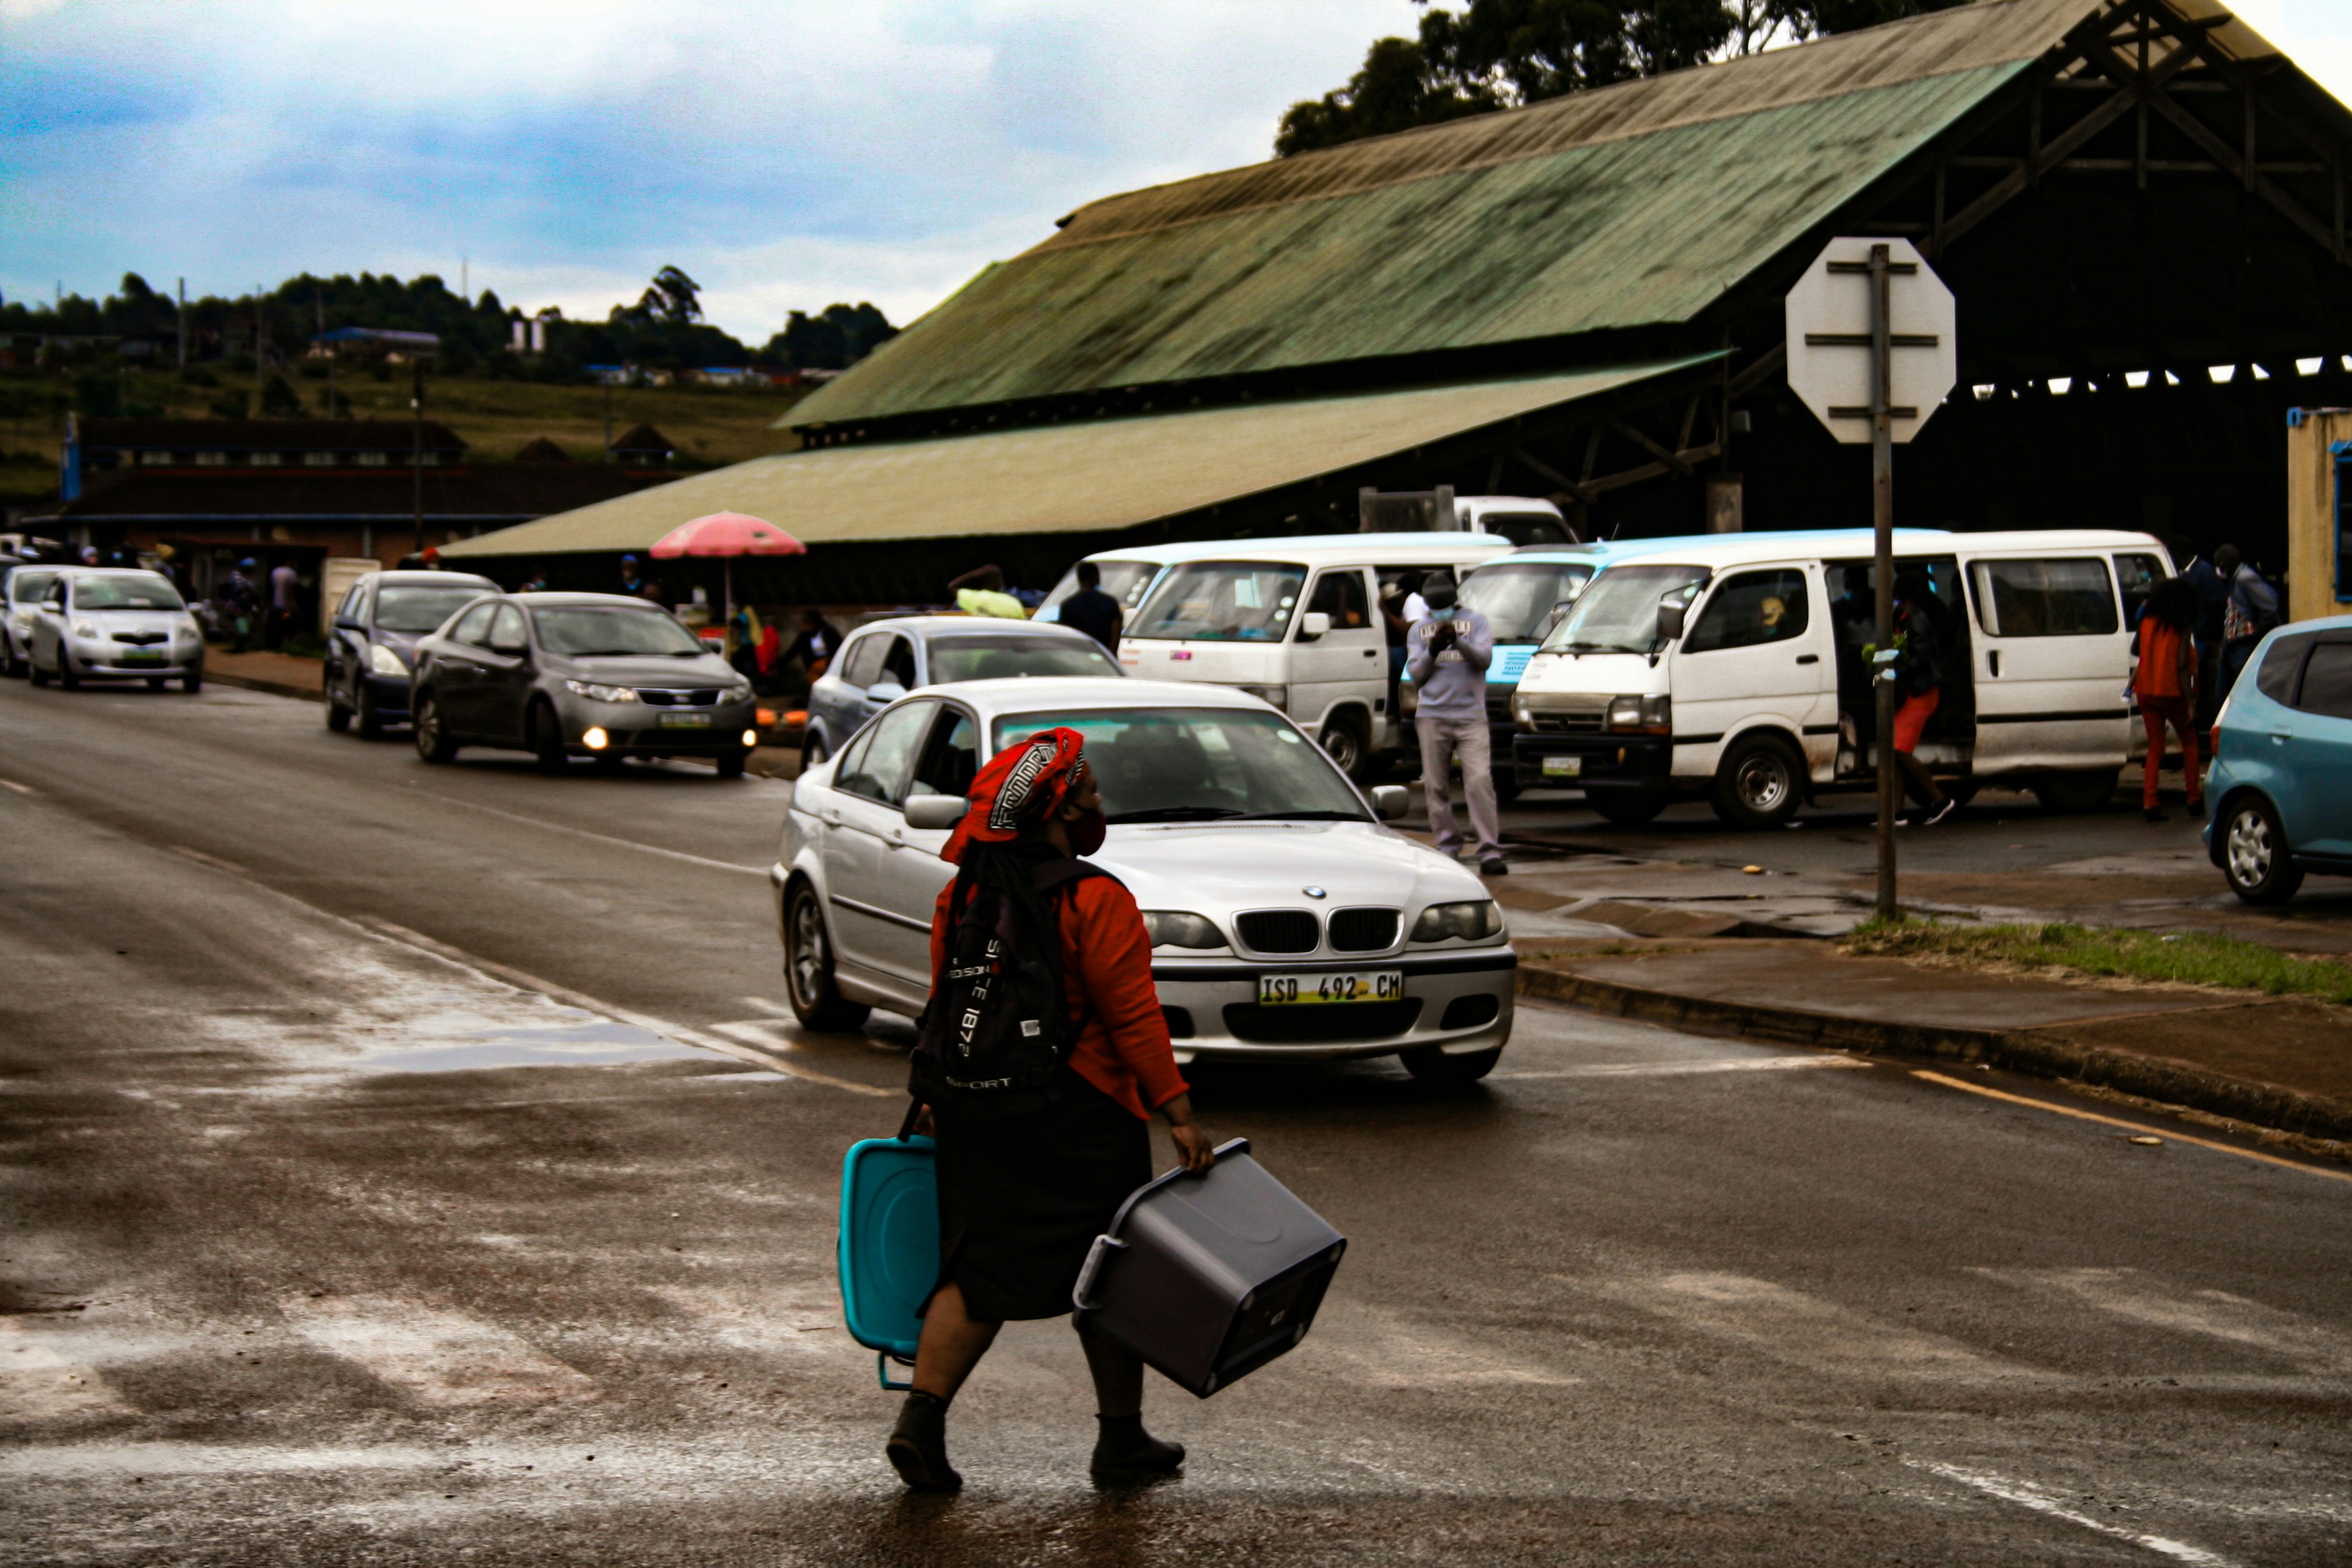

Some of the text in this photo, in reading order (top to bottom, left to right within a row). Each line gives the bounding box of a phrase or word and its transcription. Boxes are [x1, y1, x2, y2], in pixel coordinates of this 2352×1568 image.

[950, 965, 990, 978] EDISON
[972, 939, 999, 1000] SIE
[1262, 974, 1399, 1002] ISD 492 CM
[946, 1076, 1011, 1089] SPORT
